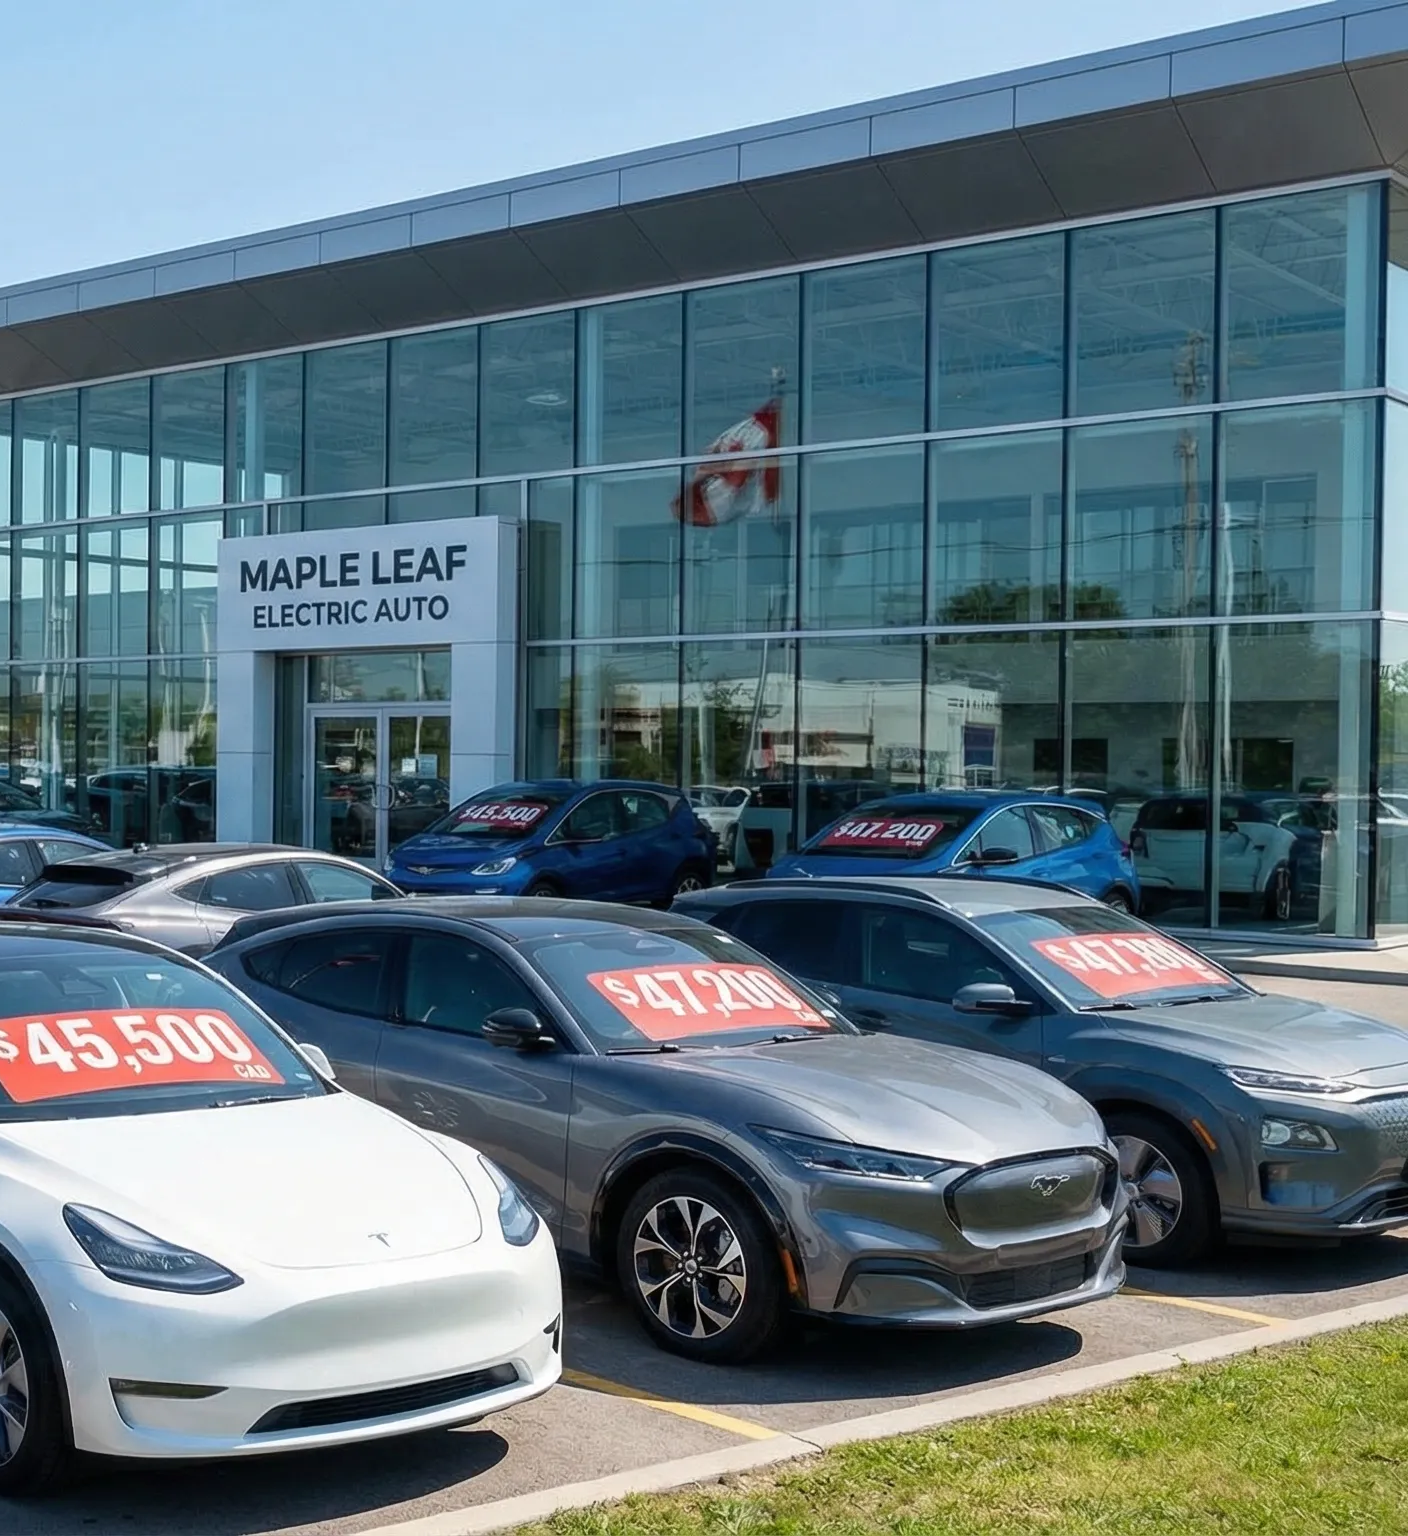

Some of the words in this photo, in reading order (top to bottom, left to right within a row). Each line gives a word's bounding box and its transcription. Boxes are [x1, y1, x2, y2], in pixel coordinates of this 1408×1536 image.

[240, 552, 360, 593] MAPLE
[372, 544, 468, 585] LEAF
[252, 600, 368, 629] ELECTRIC
[374, 595, 450, 623] AUTO
[602, 968, 802, 1018] $47,200
[233, 1063, 272, 1079] CAD
